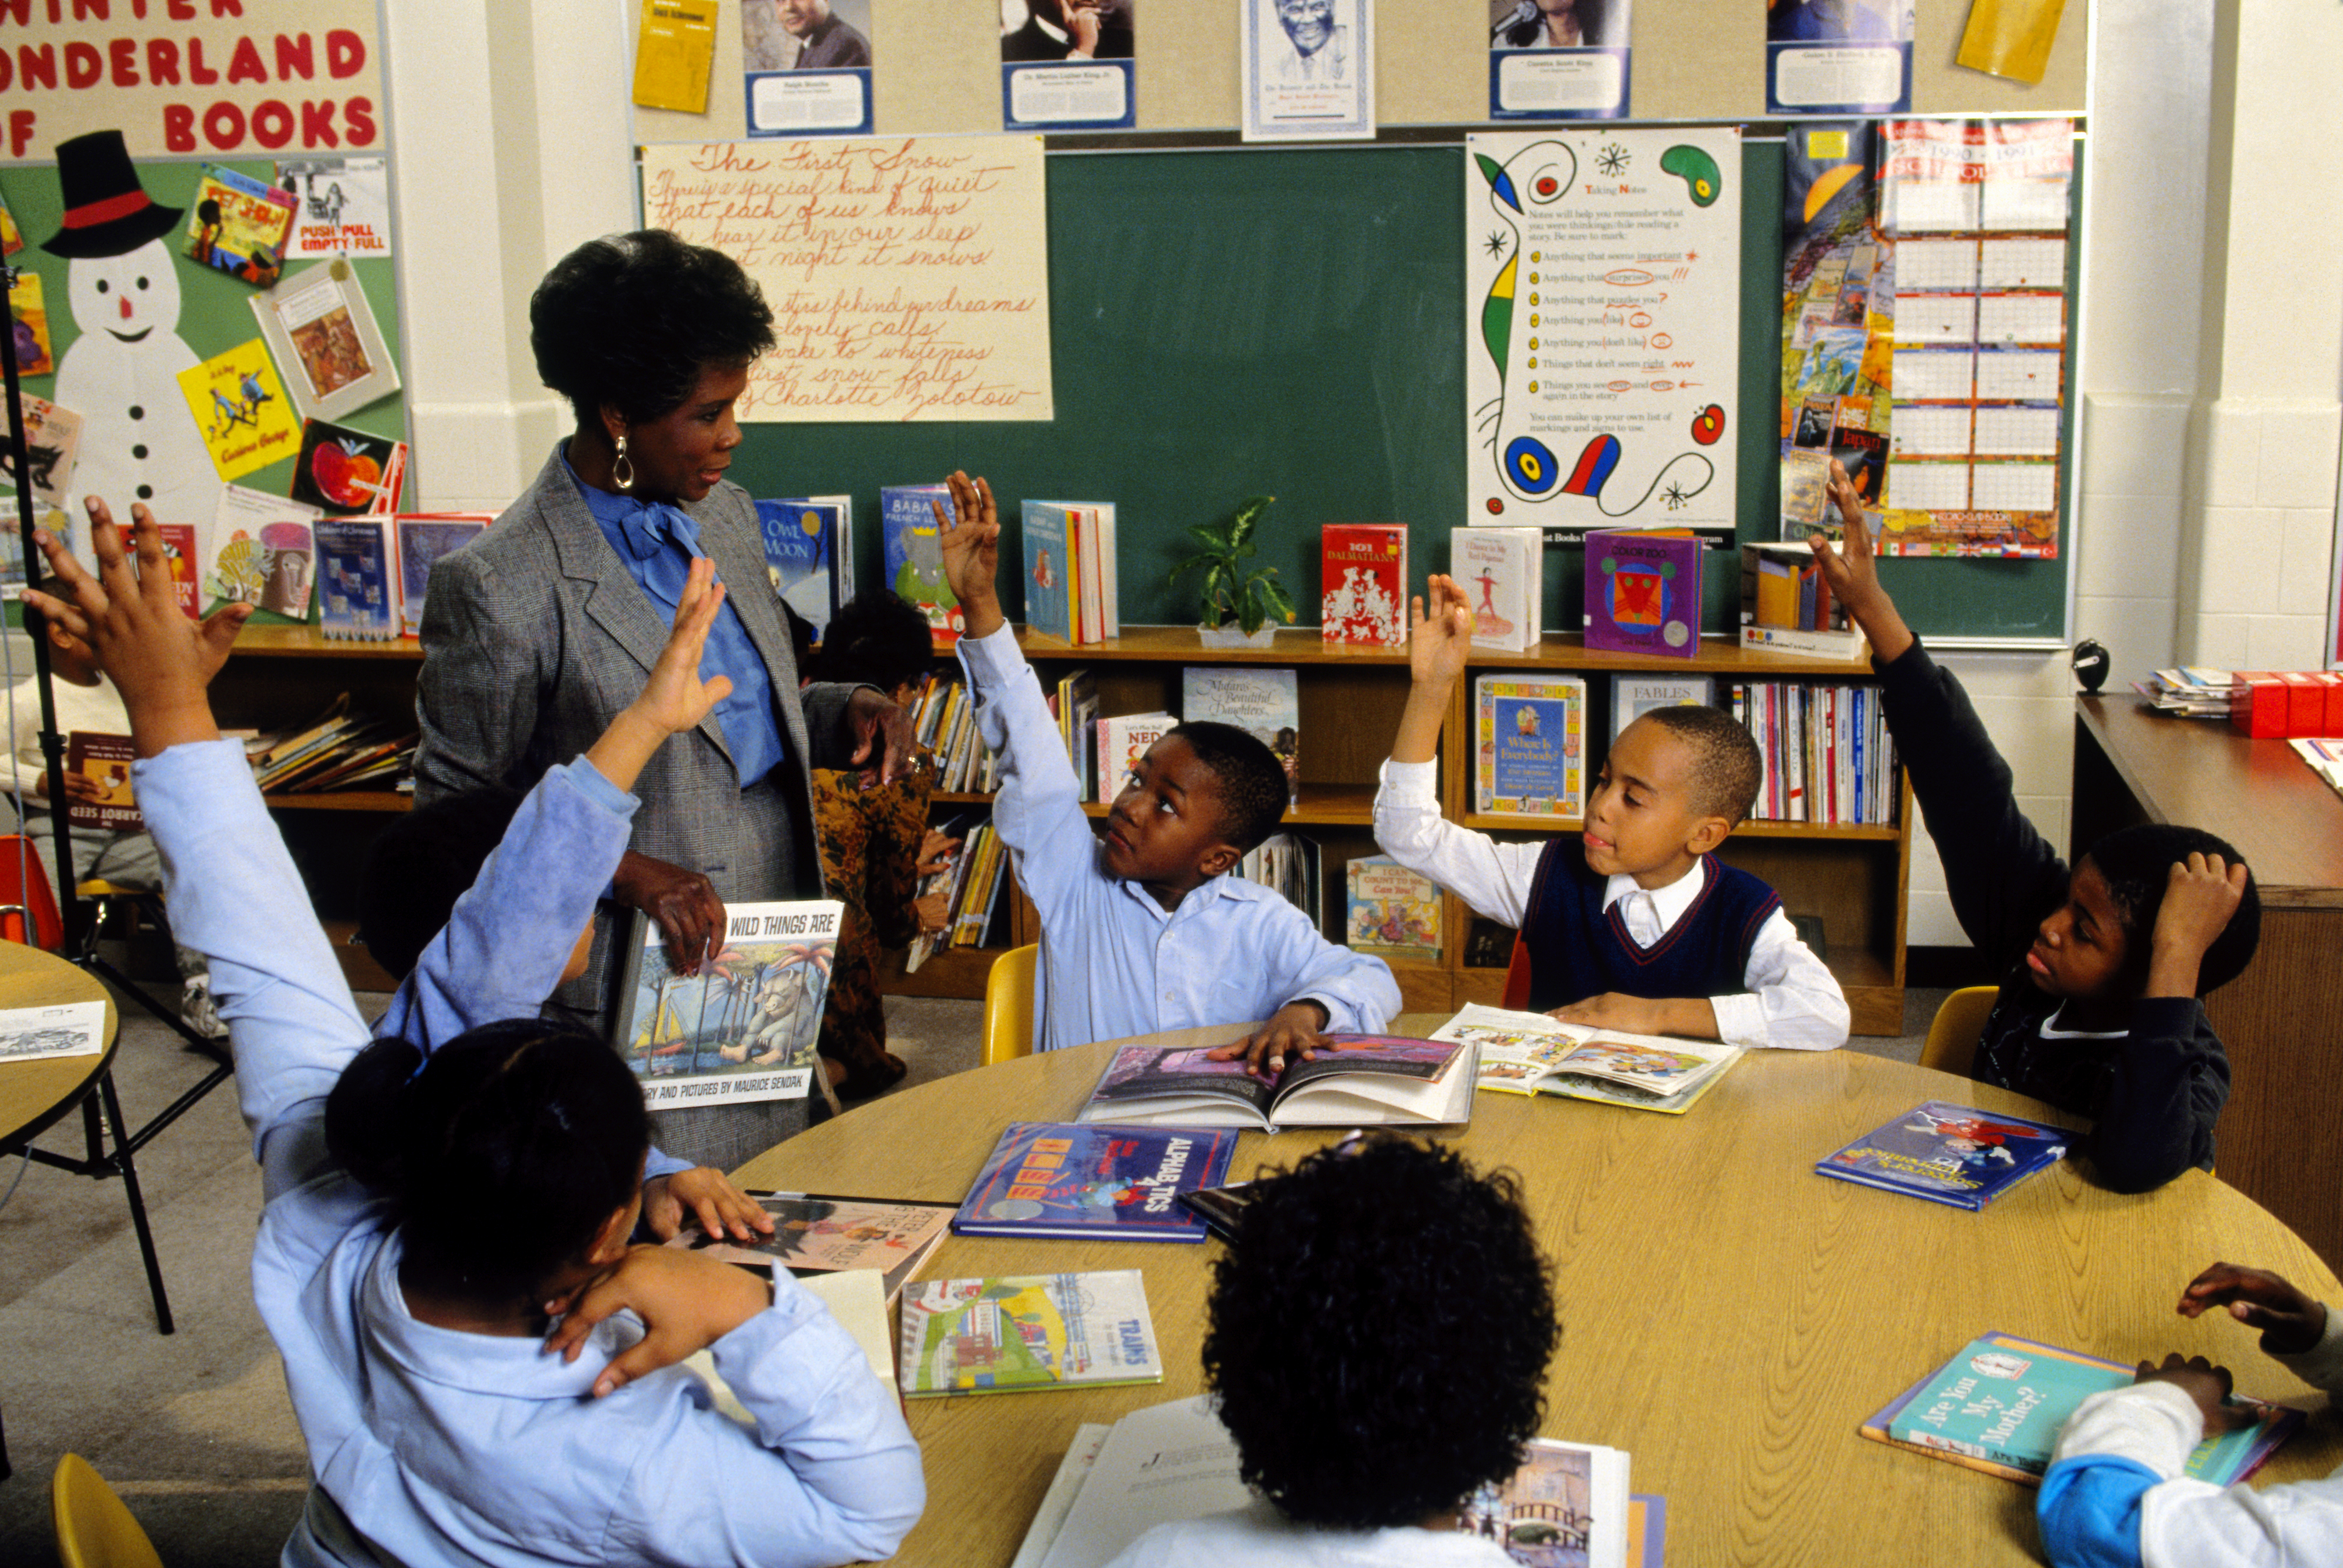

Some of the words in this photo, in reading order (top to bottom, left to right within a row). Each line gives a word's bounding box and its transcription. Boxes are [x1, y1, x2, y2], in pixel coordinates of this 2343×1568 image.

[164, 96, 376, 152] BOOKS
[691, 142, 771, 172] The
[778, 141, 870, 171] First
[869, 138, 973, 171] Snow
[736, 172, 831, 207] special
[919, 166, 1015, 205] quiet
[1585, 184, 1617, 195] Taking
[1619, 184, 1647, 194] Notes
[206, 186, 241, 209] PET
[655, 195, 720, 219] that
[716, 194, 788, 219] each
[798, 195, 825, 235] of
[825, 204, 868, 218] us
[874, 198, 971, 216] knows
[1529, 209, 1554, 218] Notes
[1556, 209, 1573, 218] will
[1575, 209, 1592, 220] help
[1596, 211, 1612, 220] you
[1614, 209, 1659, 218] remember
[1662, 208, 1684, 217] what
[301, 225, 335, 238] PUSH
[342, 223, 374, 236] PULL
[849, 225, 904, 242] our
[908, 215, 982, 249] sleep
[301, 237, 349, 251] EMPTY
[354, 236, 384, 249] FULL
[769, 235, 859, 282] night
[856, 242, 903, 265] it
[1543, 252, 1585, 262] Anything
[1588, 252, 1605, 260] that
[1637, 252, 1682, 261] important
[1543, 273, 1585, 283] Anything
[825, 286, 904, 315] behind
[935, 286, 1036, 312] dreams
[1543, 295, 1585, 305] Anything
[1588, 295, 1604, 303] that
[1543, 315, 1585, 326] Anything
[832, 337, 872, 359] to
[874, 336, 994, 361] whiteness
[1542, 338, 1584, 348] Anything
[1543, 359, 1574, 369] Things
[1575, 358, 1592, 368] that
[1643, 359, 1665, 369] right
[813, 367, 893, 383] snow
[894, 359, 978, 396] falls
[1543, 381, 1574, 391] Things
[763, 380, 892, 406] Charlotte
[894, 379, 1041, 421] Zolotow
[1530, 413, 1546, 421] You
[1530, 423, 1572, 433] markings
[1574, 423, 1590, 432] and
[221, 442, 257, 464] Curious
[259, 428, 289, 448] George
[1841, 430, 1881, 449] Japan
[892, 499, 956, 516] BABA'S
[767, 519, 801, 539] OWL
[1555, 533, 1581, 542] Books
[763, 538, 808, 558] MOON
[1349, 542, 1372, 552] 101
[1610, 545, 1644, 557] COLOR
[1647, 546, 1667, 559] ZOO
[1327, 551, 1396, 562] DALMATIANS
[1213, 690, 1275, 706] Beautiful
[1633, 686, 1691, 699] FABLES
[1209, 702, 1268, 722] Daughters
[1507, 736, 1541, 749] Where
[1542, 738, 1551, 749] Is
[1501, 748, 1559, 763] Everybody?
[70, 806, 98, 818] SEED
[100, 807, 144, 822] CARROT
[1373, 885, 1392, 894] Can
[729, 916, 760, 937] WILD
[764, 915, 806, 935] THINGS
[809, 913, 835, 932] ARE
[659, 1086, 676, 1099] AND
[680, 1082, 718, 1097] PICTURES
[721, 1081, 732, 1094] BY
[733, 1078, 770, 1093] MAURICE
[771, 1075, 804, 1089] SENDAK
[875, 1213, 909, 1228] THE
[900, 1210, 939, 1232] PETER
[829, 1244, 872, 1265] WOLF
[1118, 1319, 1148, 1366] TRAINS
[1919, 1401, 1955, 1430] Are
[1939, 1377, 1979, 1400] You
[1961, 1394, 2004, 1419] My
[1979, 1386, 2047, 1447] Mother?
[1991, 1450, 2012, 1463] Are
